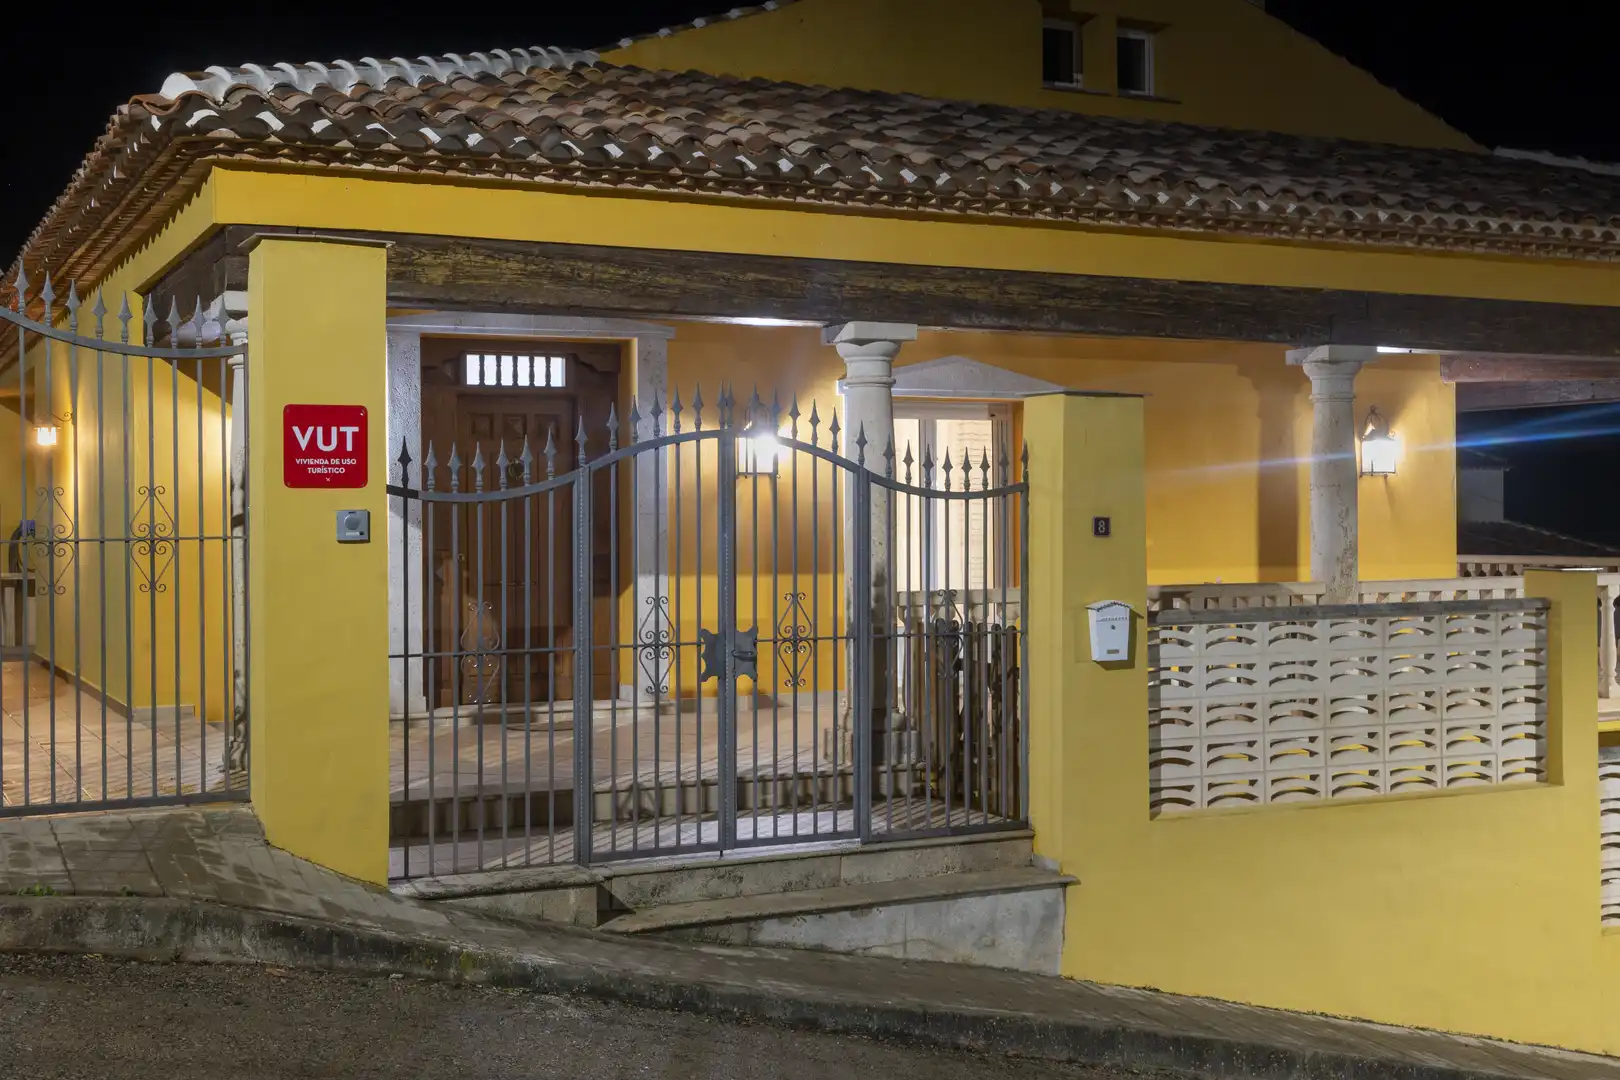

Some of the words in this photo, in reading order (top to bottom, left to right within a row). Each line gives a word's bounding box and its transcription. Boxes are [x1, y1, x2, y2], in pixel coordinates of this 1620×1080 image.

[292, 425, 360, 452] VUT
[307, 465, 346, 474] TURÍSTICO
[1098, 519, 1105, 533] 8
